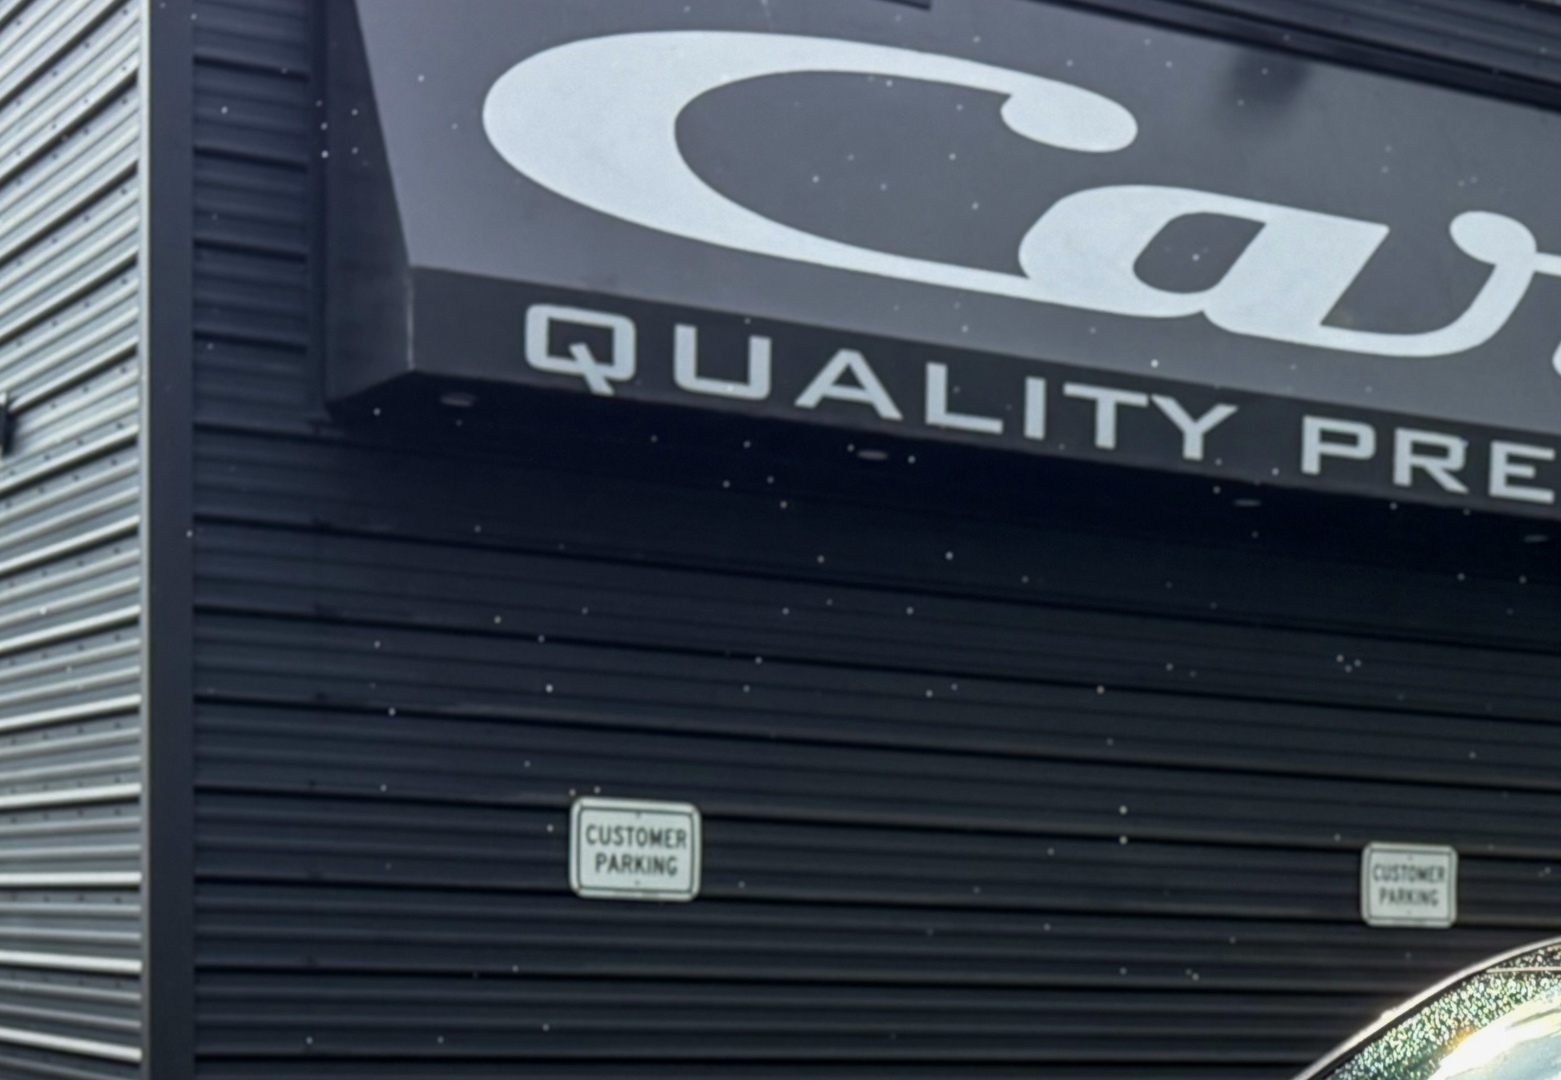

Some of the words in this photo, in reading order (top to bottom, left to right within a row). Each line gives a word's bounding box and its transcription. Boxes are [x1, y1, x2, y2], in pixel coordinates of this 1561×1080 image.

[525, 303, 1239, 461] QUALITY
[585, 824, 688, 849] CUSTOMER
[595, 853, 679, 877] PARKING
[1373, 864, 1445, 884] CUSTOMER
[1379, 888, 1439, 907] PARKING
